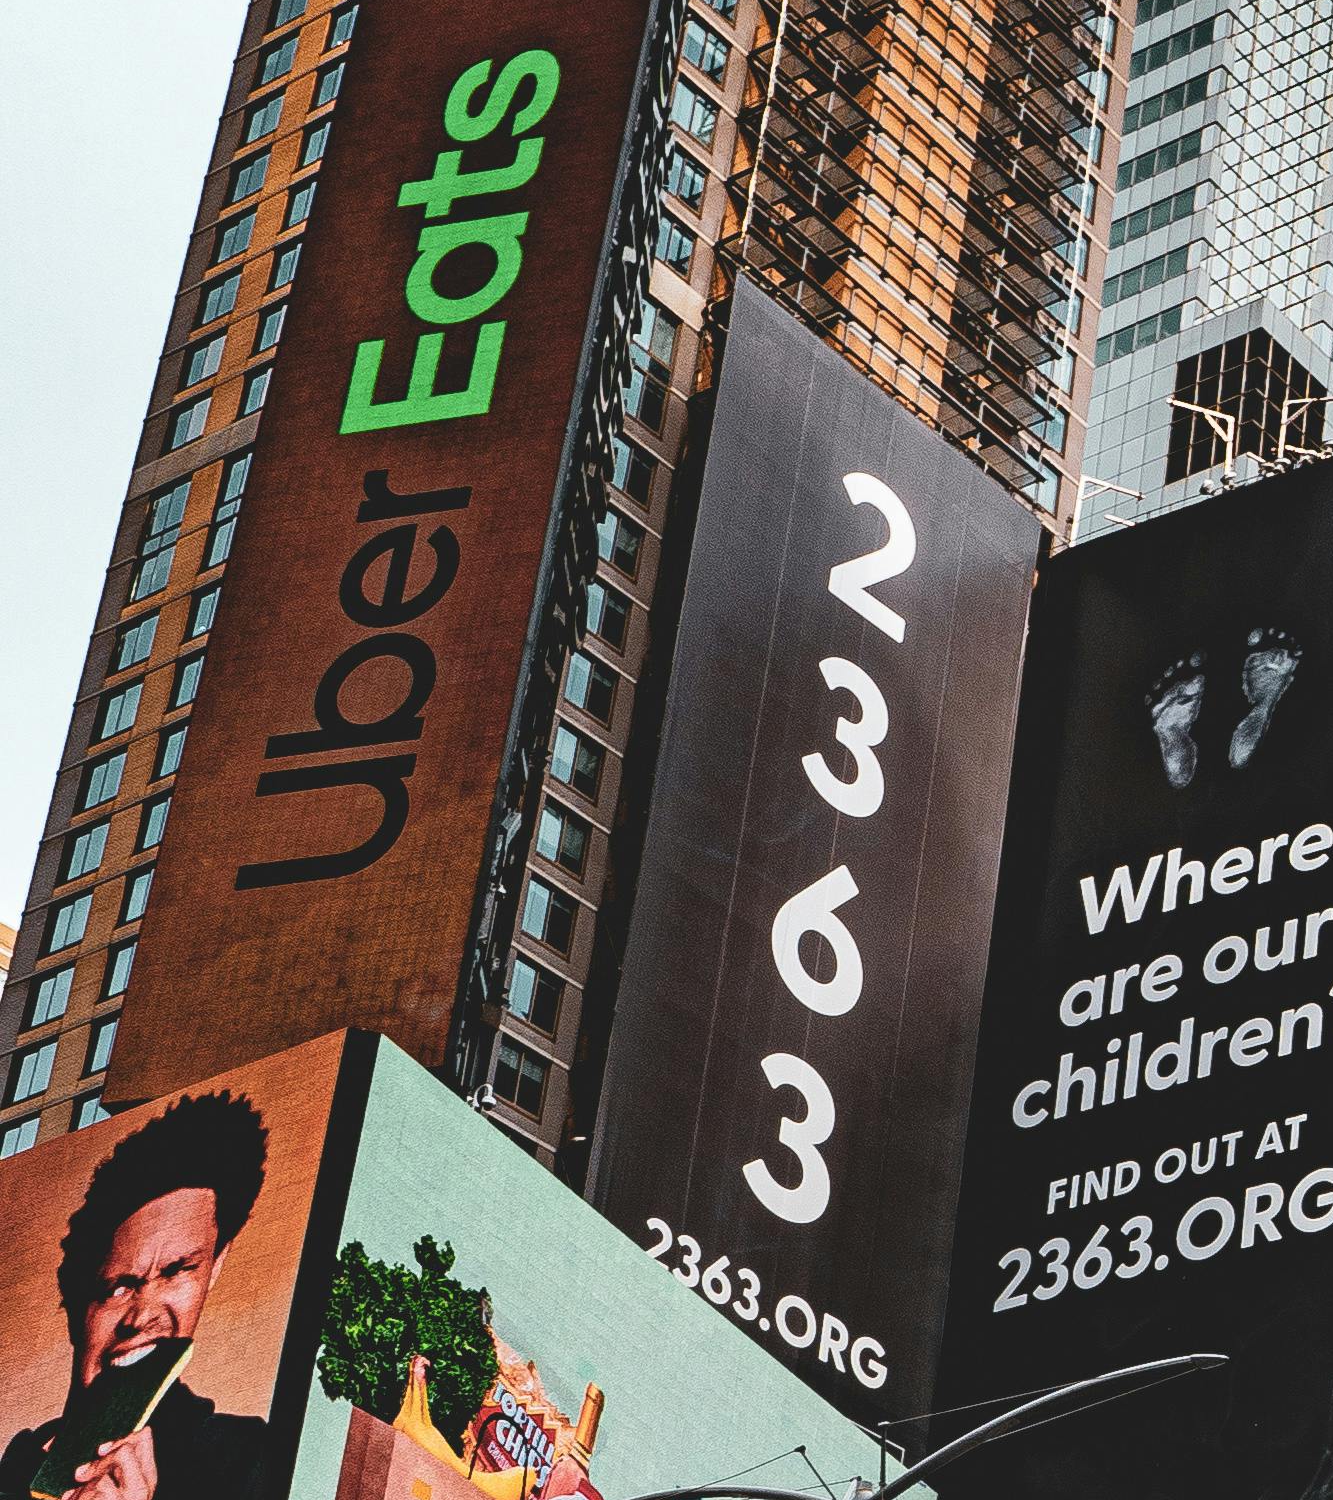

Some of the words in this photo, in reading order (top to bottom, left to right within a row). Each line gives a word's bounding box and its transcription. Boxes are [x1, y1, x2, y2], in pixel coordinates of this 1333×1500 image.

[339, 49, 562, 436] Eats
[234, 469, 472, 891] Uber
[742, 472, 917, 1225] 2363
[1058, 955, 1184, 1028] are
[642, 1216, 889, 1389] 2363.ORG
[1046, 1157, 1139, 1215] FIND
[1153, 1130, 1243, 1184] OUT
[1254, 1114, 1308, 1162] AT
